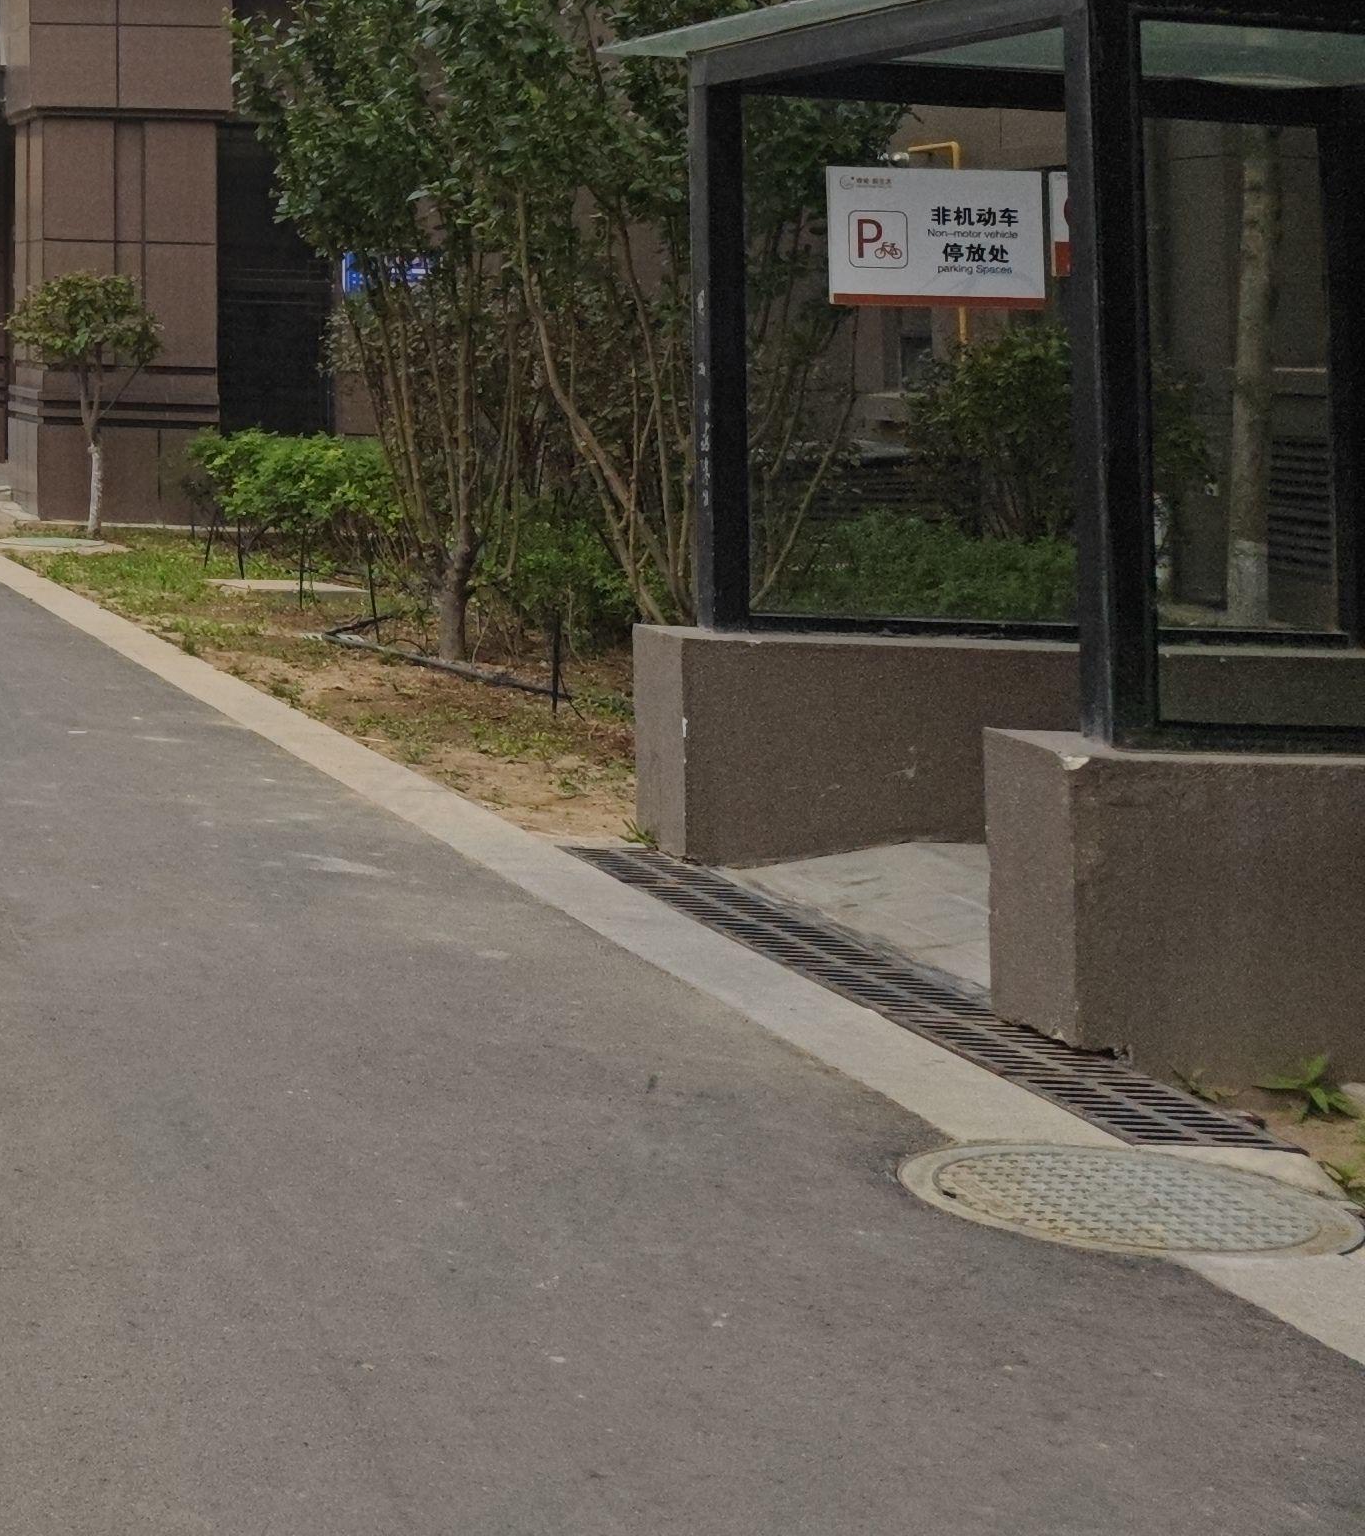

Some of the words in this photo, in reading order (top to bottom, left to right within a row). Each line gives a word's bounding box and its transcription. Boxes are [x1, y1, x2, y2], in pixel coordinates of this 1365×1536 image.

[930, 206, 1019, 227] 非机动车
[857, 218, 883, 259] P
[927, 229, 982, 239] Non-motor
[984, 230, 1019, 240] vehicle
[942, 243, 1010, 263] 停放处
[937, 264, 973, 276] parking
